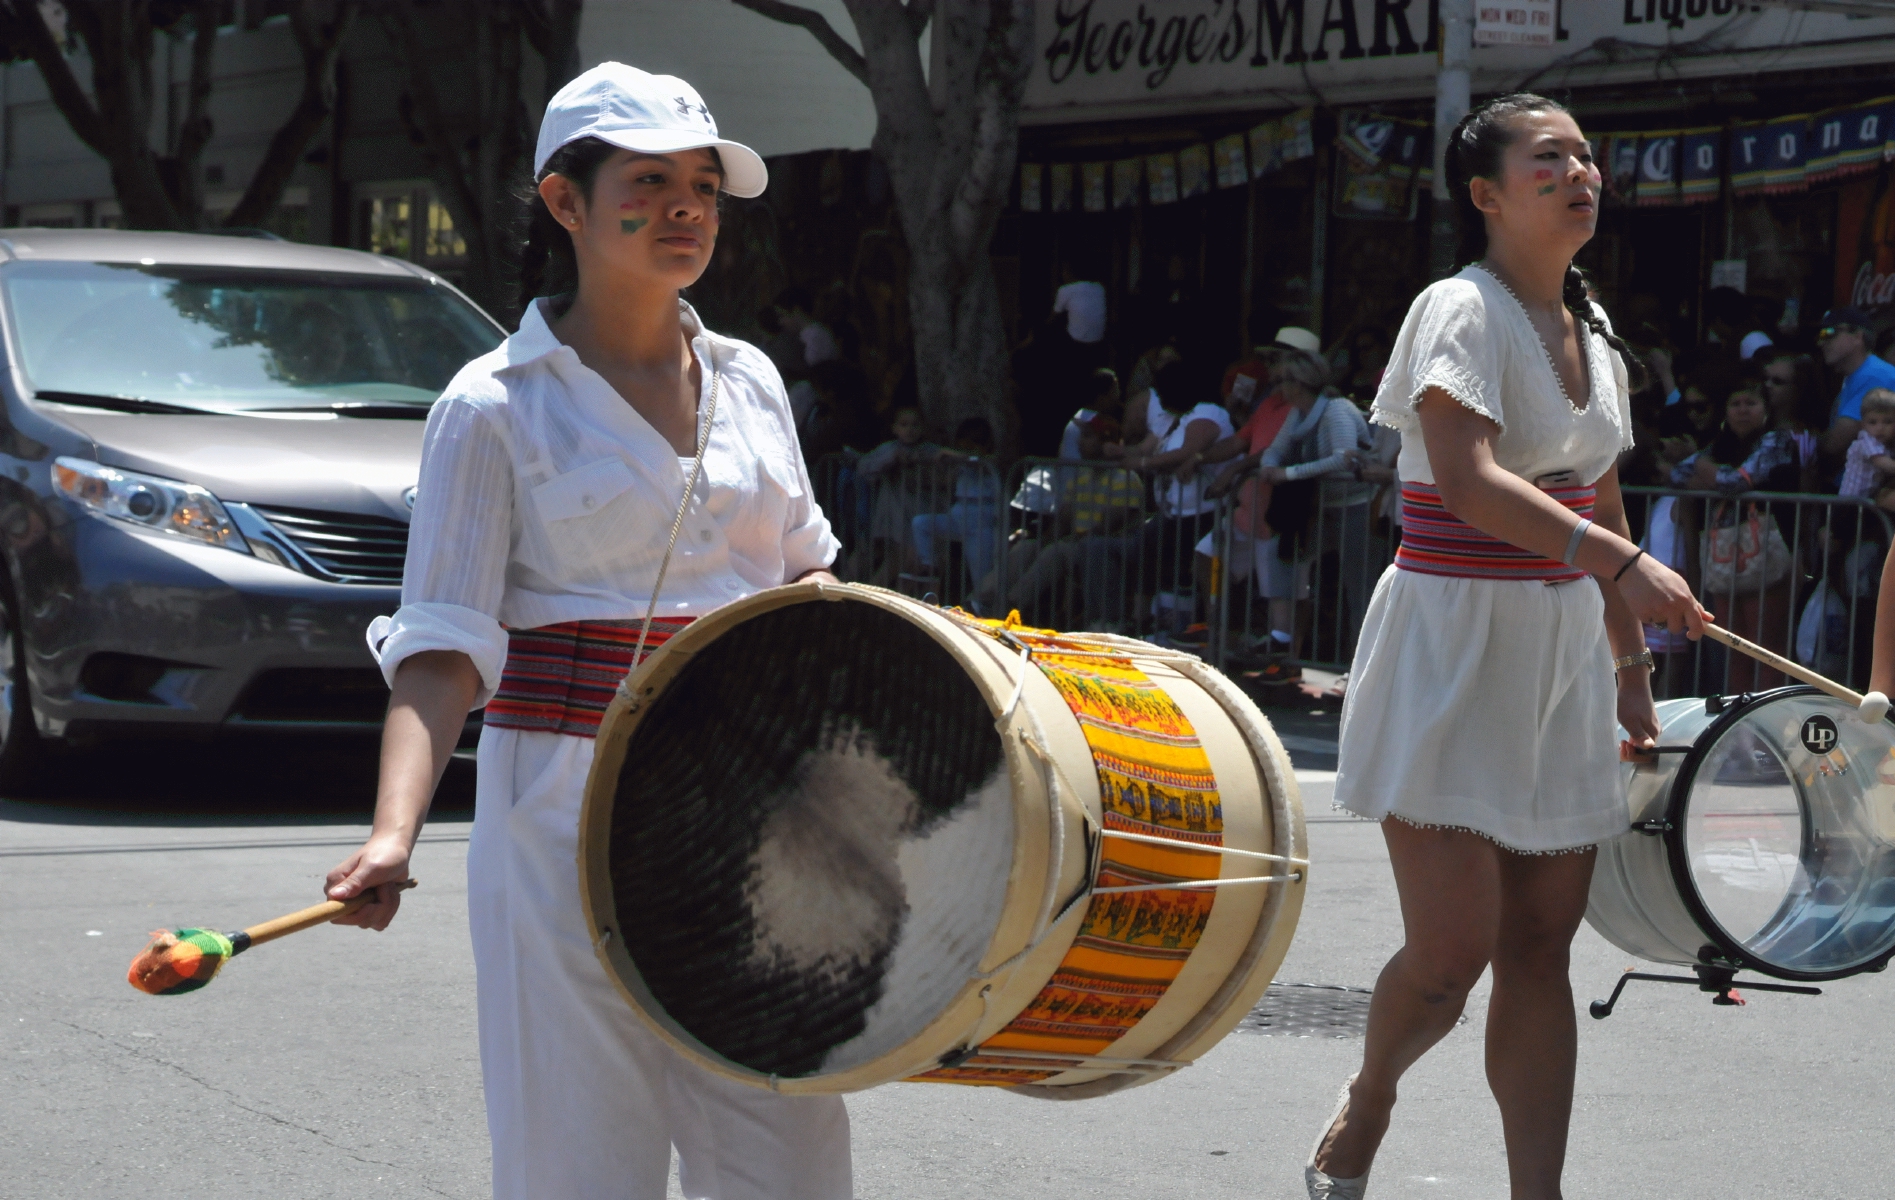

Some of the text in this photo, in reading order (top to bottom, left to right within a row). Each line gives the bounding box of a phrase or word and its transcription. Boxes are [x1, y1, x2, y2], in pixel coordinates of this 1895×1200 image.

[1480, 8, 1550, 26] MON WED FRI
[1044, 0, 1252, 90] George's
[1643, 115, 1879, 180] Corona
[1807, 722, 1835, 750] LP
